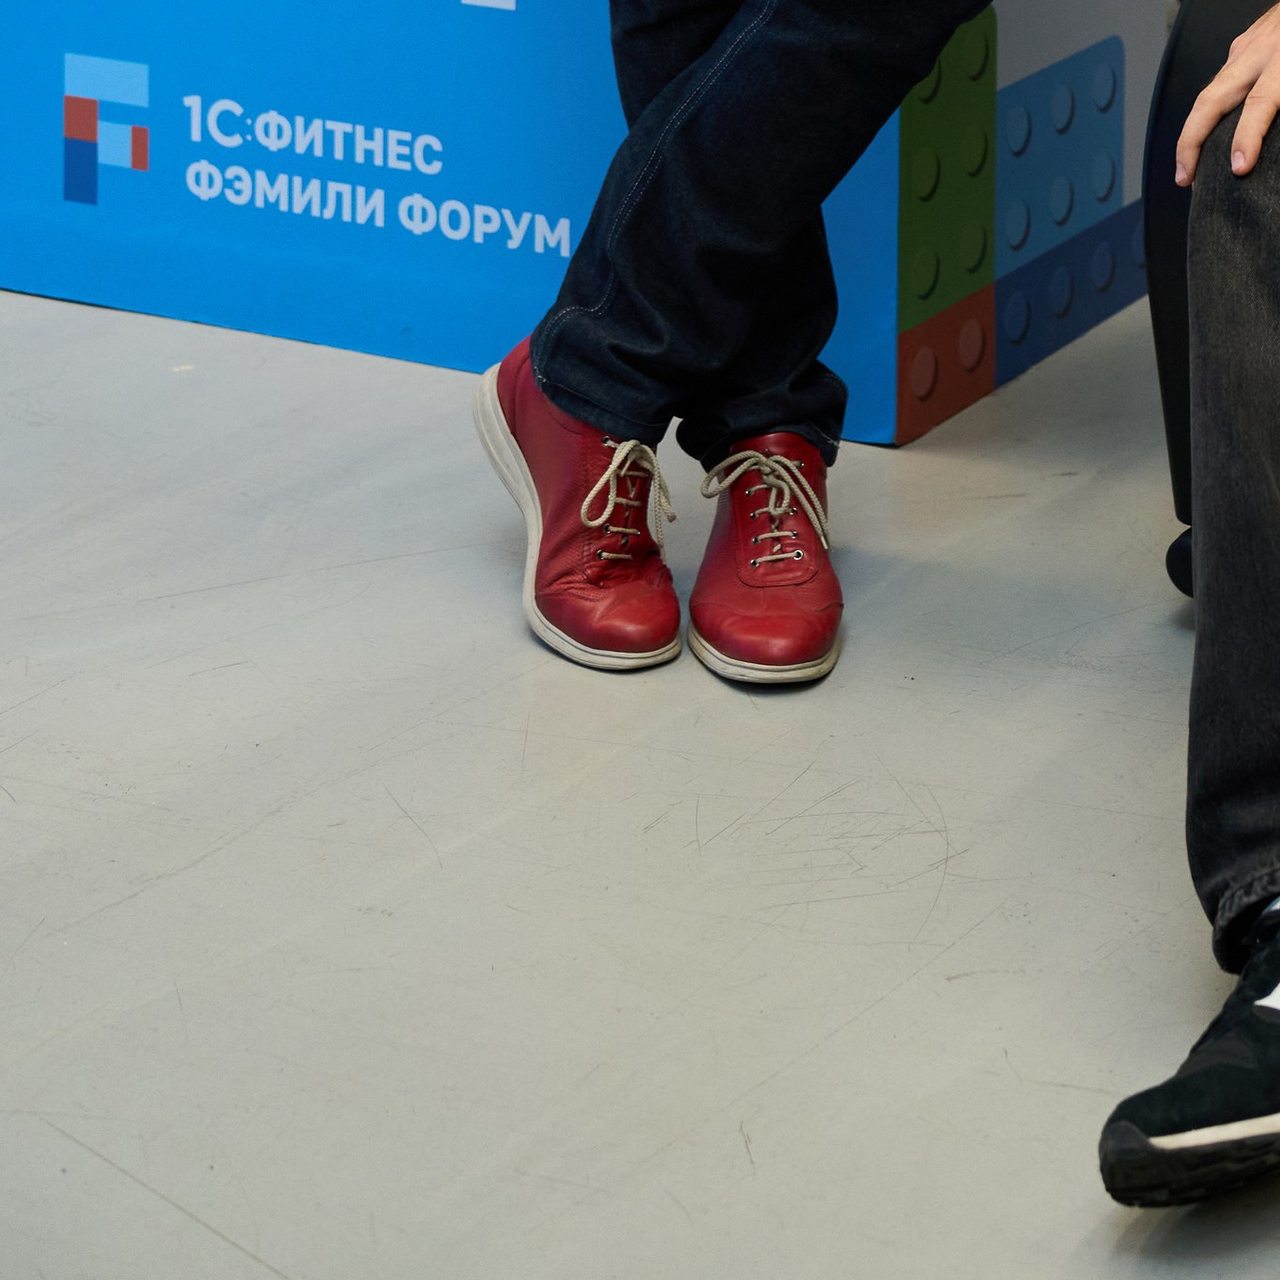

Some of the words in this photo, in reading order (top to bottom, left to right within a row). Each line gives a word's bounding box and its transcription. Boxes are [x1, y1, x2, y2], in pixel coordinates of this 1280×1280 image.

[182, 94, 444, 176] 1С:ФИТНЕС
[185, 160, 386, 229] ФЭМИЛИ
[398, 192, 571, 258] ФОРУМ
